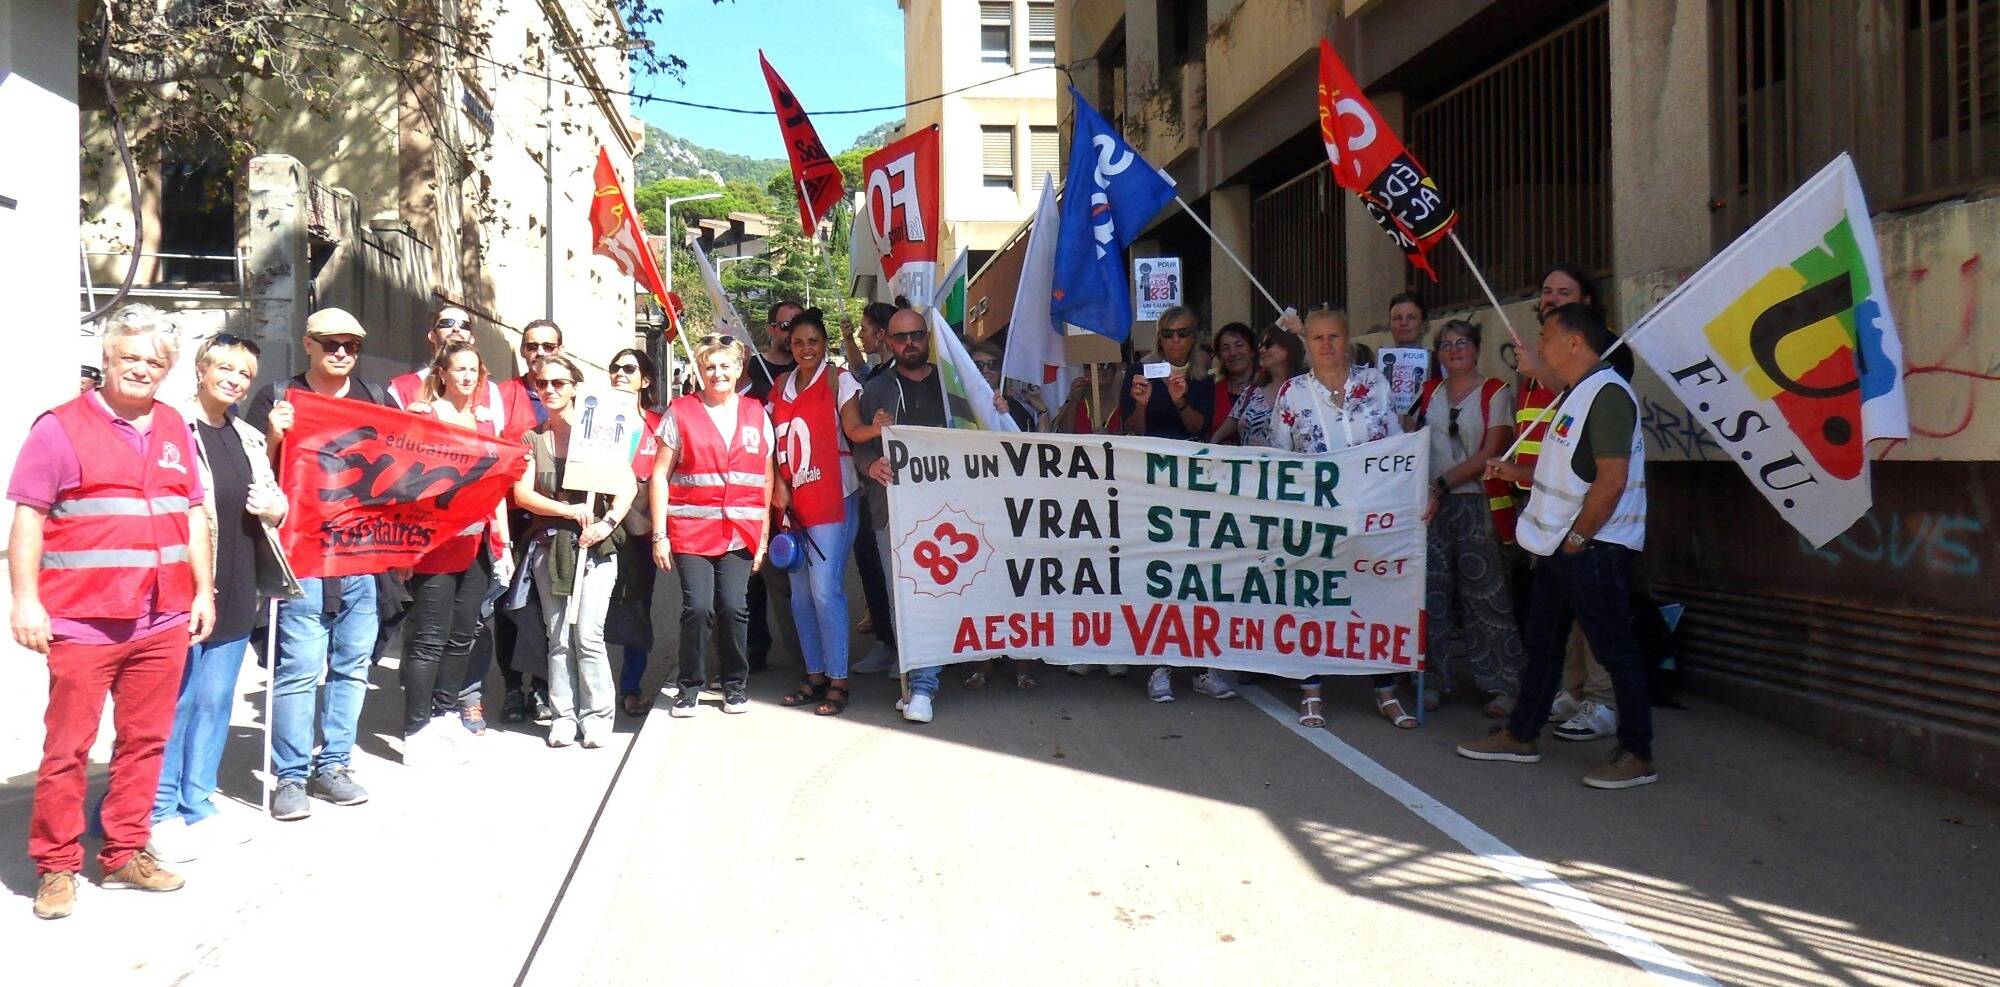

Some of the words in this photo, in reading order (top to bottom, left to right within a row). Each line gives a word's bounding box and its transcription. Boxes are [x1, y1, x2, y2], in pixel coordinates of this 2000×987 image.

[1151, 287, 1170, 300] 83
[1392, 379, 1415, 393] 83
[385, 431, 470, 465] éducation
[964, 454, 999, 478] UN
[1365, 455, 1416, 473] FCPE
[1147, 505, 1347, 559] STATUT
[1365, 513, 1394, 533] FO
[913, 522, 980, 585] 83
[1354, 558, 1408, 576] CGT
[952, 611, 1055, 653] AESH
[1072, 611, 1112, 646] DU
[1120, 603, 1223, 658] VAR
[1229, 617, 1265, 650] EN
